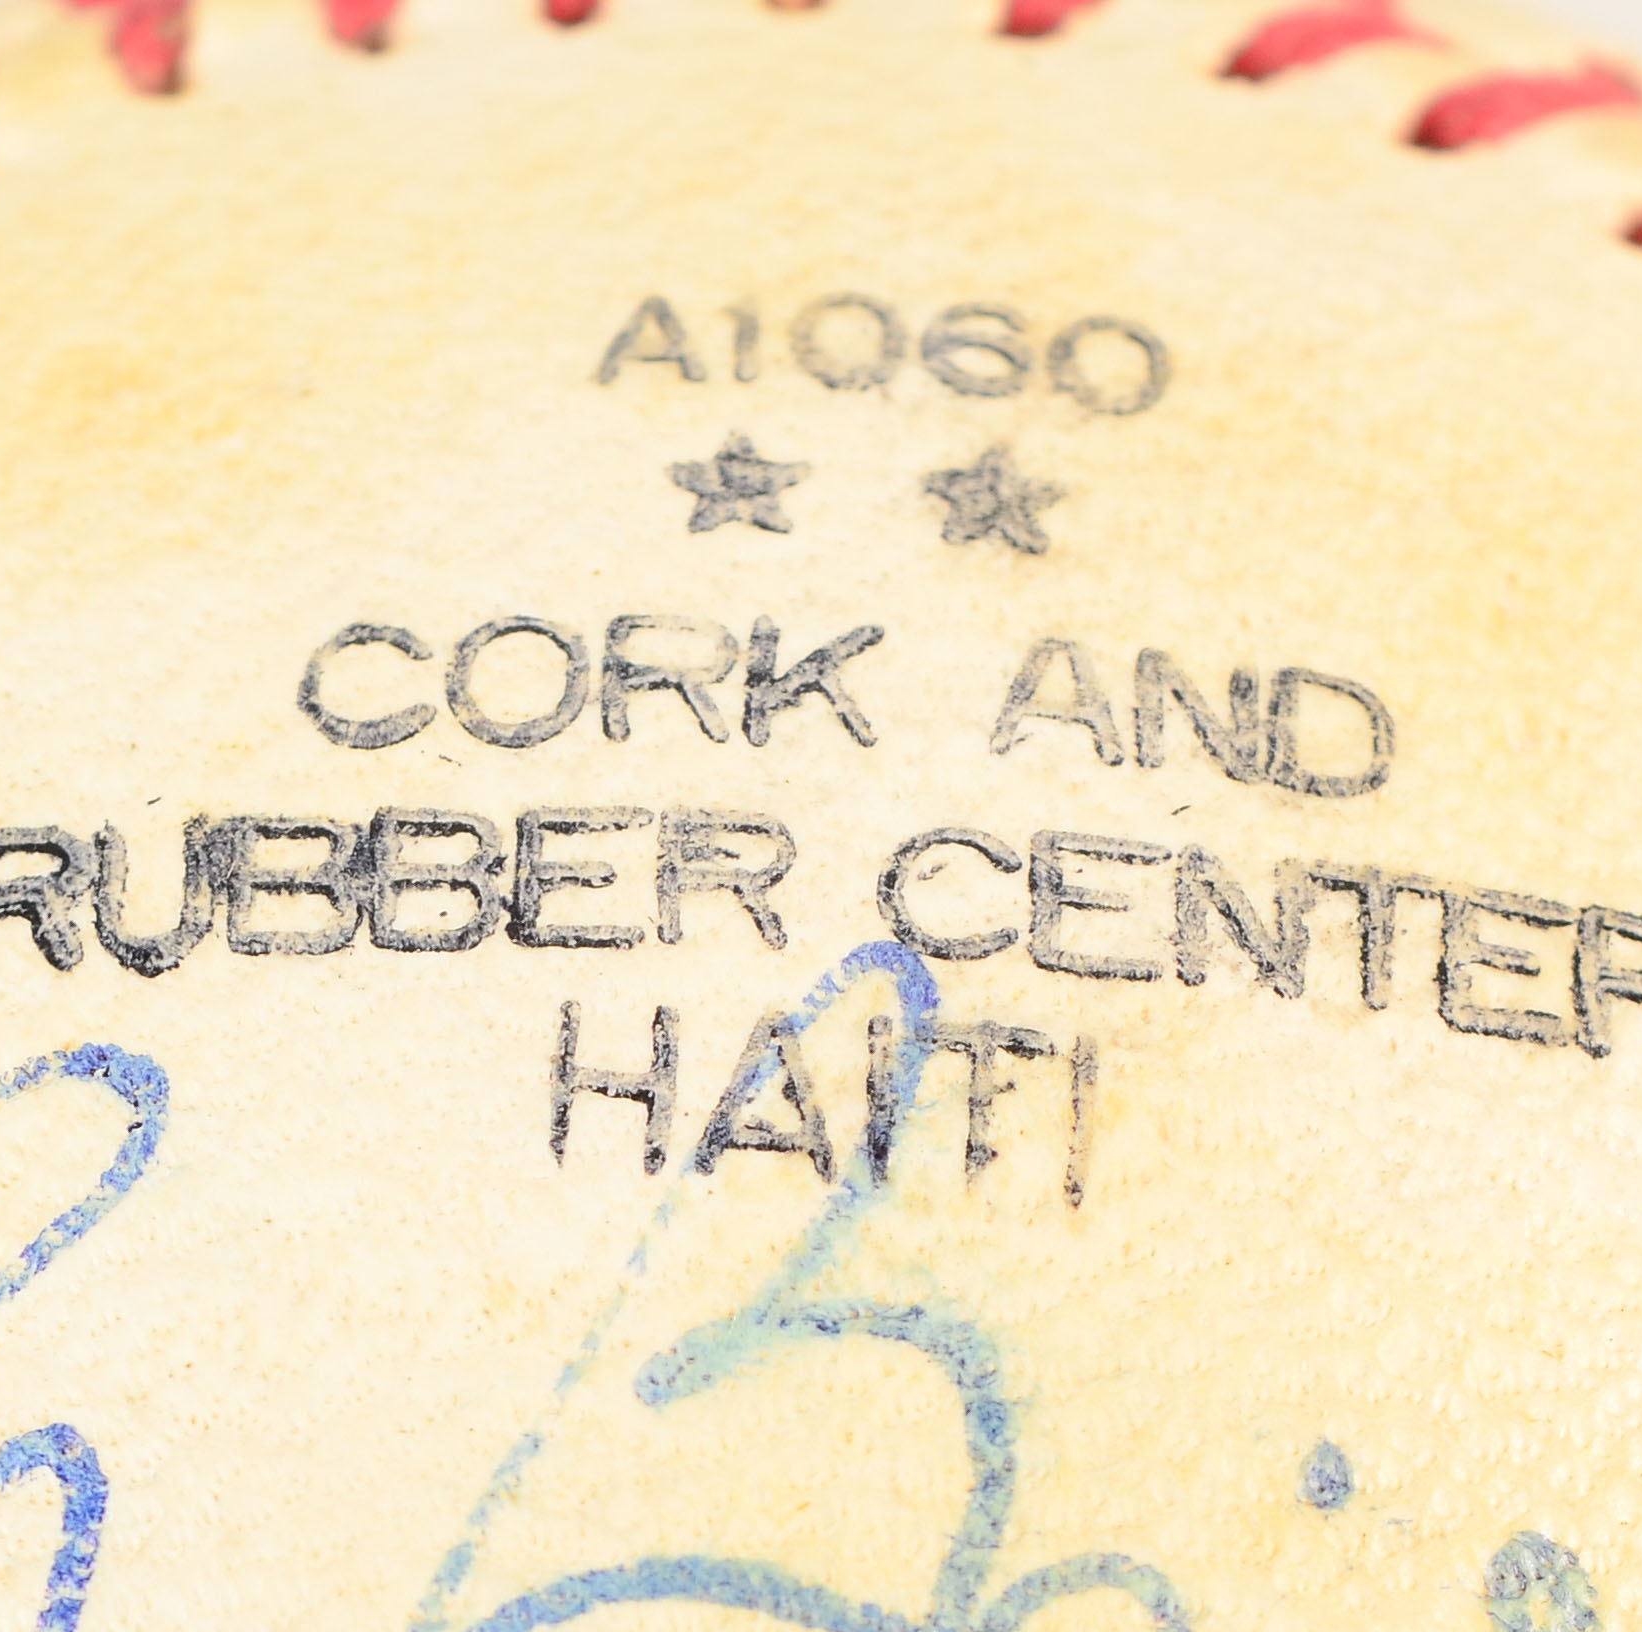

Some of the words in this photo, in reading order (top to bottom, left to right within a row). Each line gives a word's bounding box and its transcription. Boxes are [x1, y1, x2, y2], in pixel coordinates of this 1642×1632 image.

[595, 294, 1169, 416] A1060
[298, 614, 887, 750] CORK
[991, 636, 1398, 798] AND
[549, 1003, 1101, 1208] HAITI
